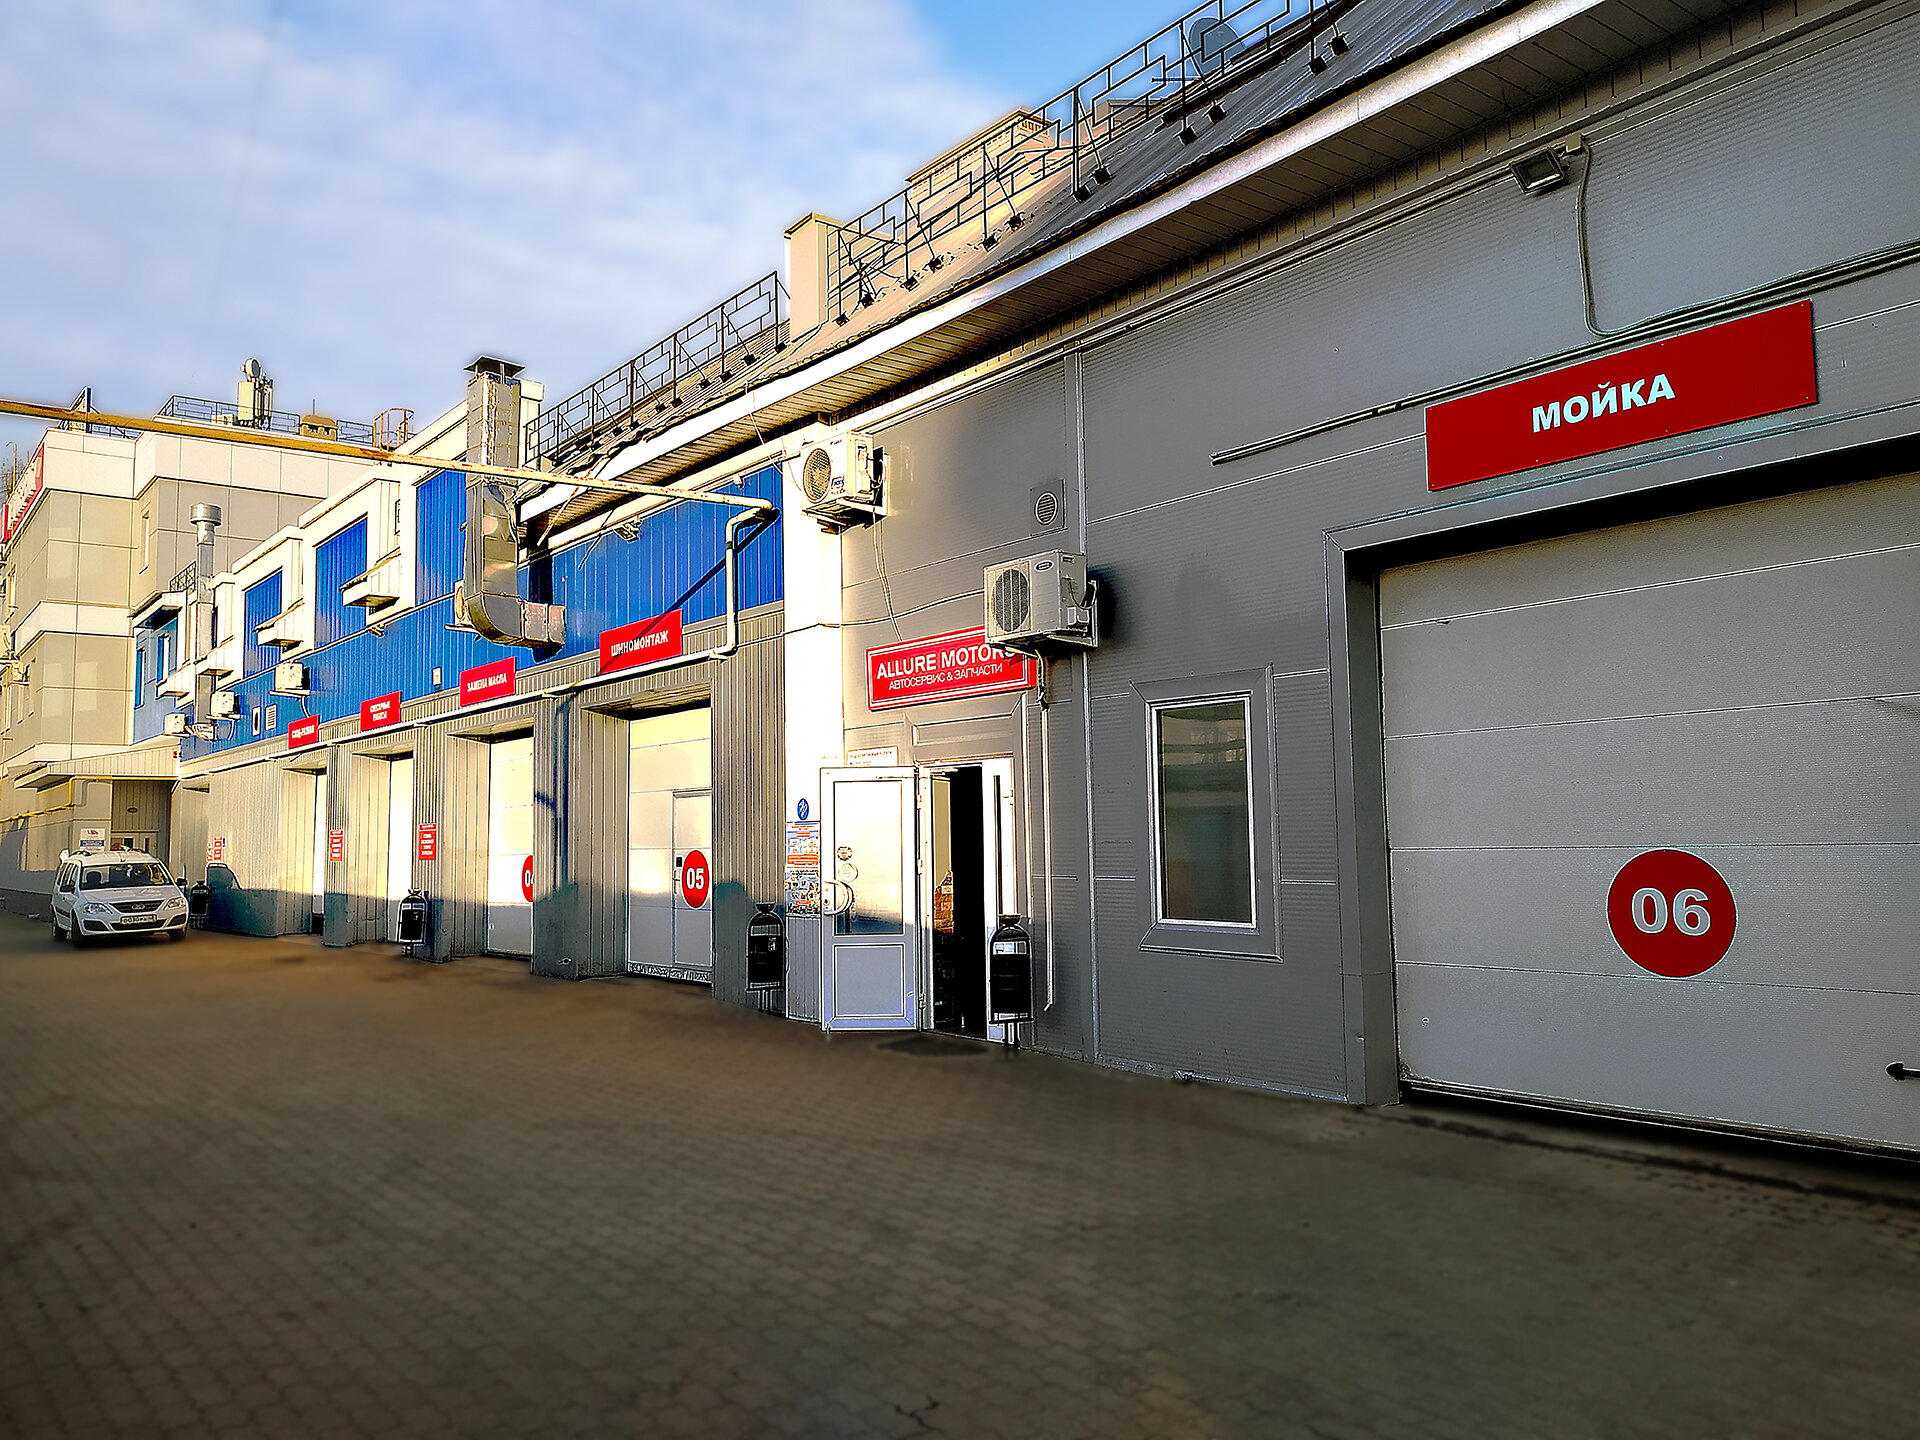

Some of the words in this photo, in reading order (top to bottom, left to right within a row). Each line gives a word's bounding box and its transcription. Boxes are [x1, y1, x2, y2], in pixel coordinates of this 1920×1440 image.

[1532, 372, 1677, 433] МОЙКА
[610, 629, 669, 657] ШИНОМОНТАЖ
[876, 653, 937, 680] ALLURE
[888, 672, 946, 691] АВТОСЕРВИС
[946, 671, 953, 682] &
[953, 662, 1004, 680] ЗАПЧАСТИ
[466, 678, 488, 693] ЗАМЕНА
[488, 672, 508, 687] МАСЛА
[686, 867, 705, 890] 05
[1631, 887, 1711, 936] 06
